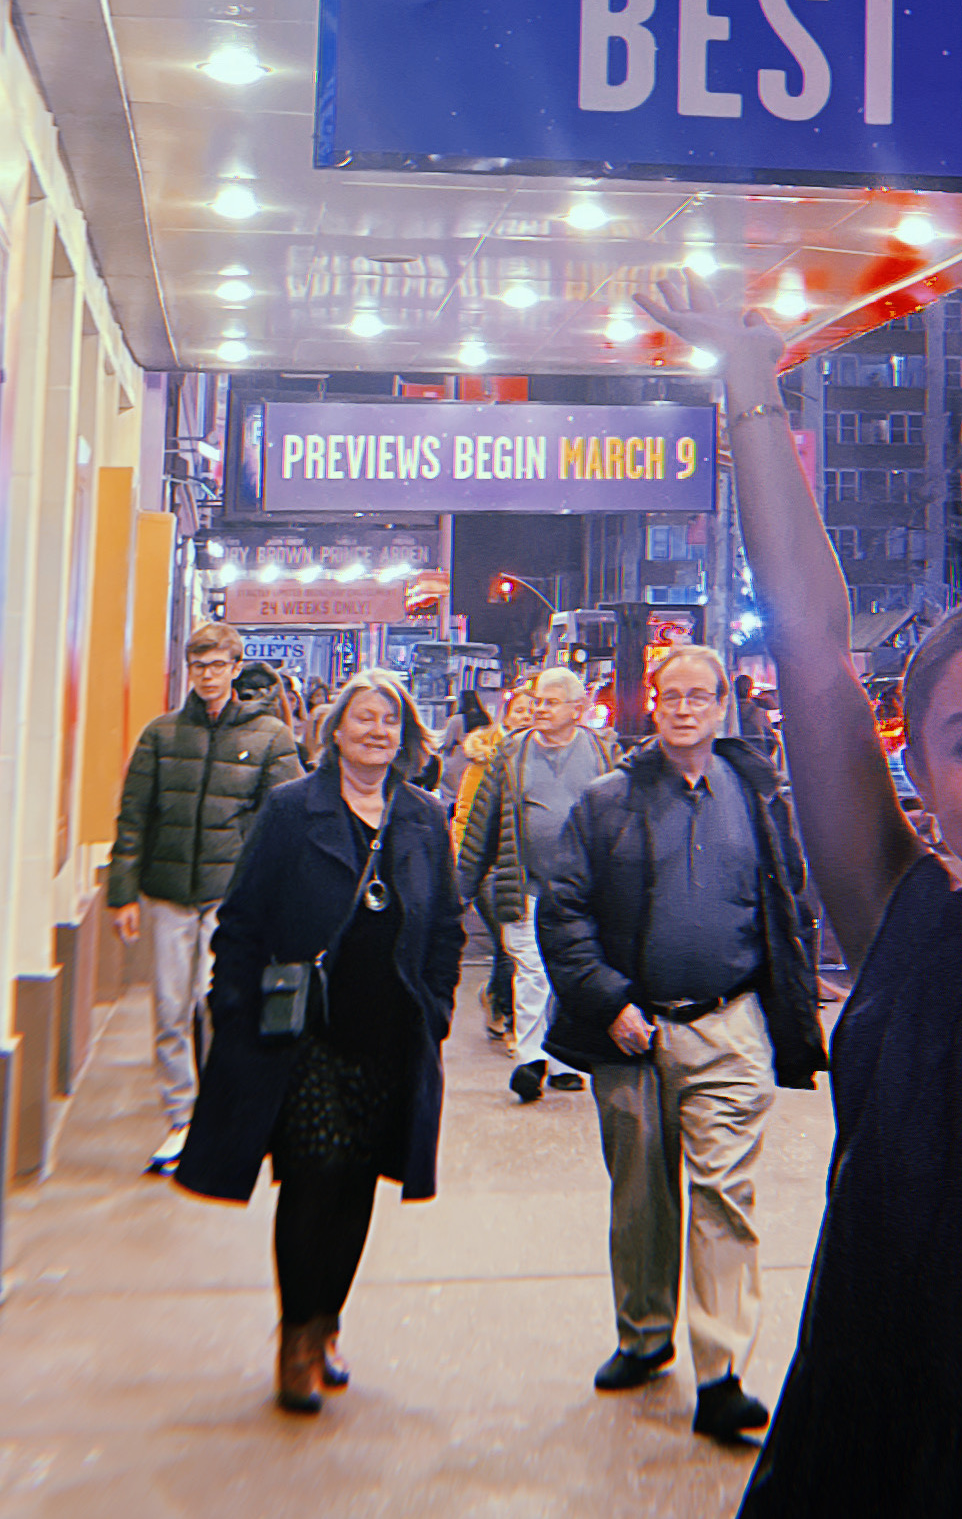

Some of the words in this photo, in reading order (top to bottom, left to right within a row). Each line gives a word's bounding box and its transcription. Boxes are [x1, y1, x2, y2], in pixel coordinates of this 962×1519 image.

[283, 435, 441, 480] PREVIEWS
[453, 435, 546, 480] BEGIN
[558, 436, 665, 480] MARCH
[676, 436, 697, 480] 9
[257, 546, 314, 564] BROWN
[261, 601, 277, 615] 24
[282, 601, 329, 615] WEEKS
[334, 601, 370, 615] ONLY!
[244, 643, 304, 658] GIFTS
